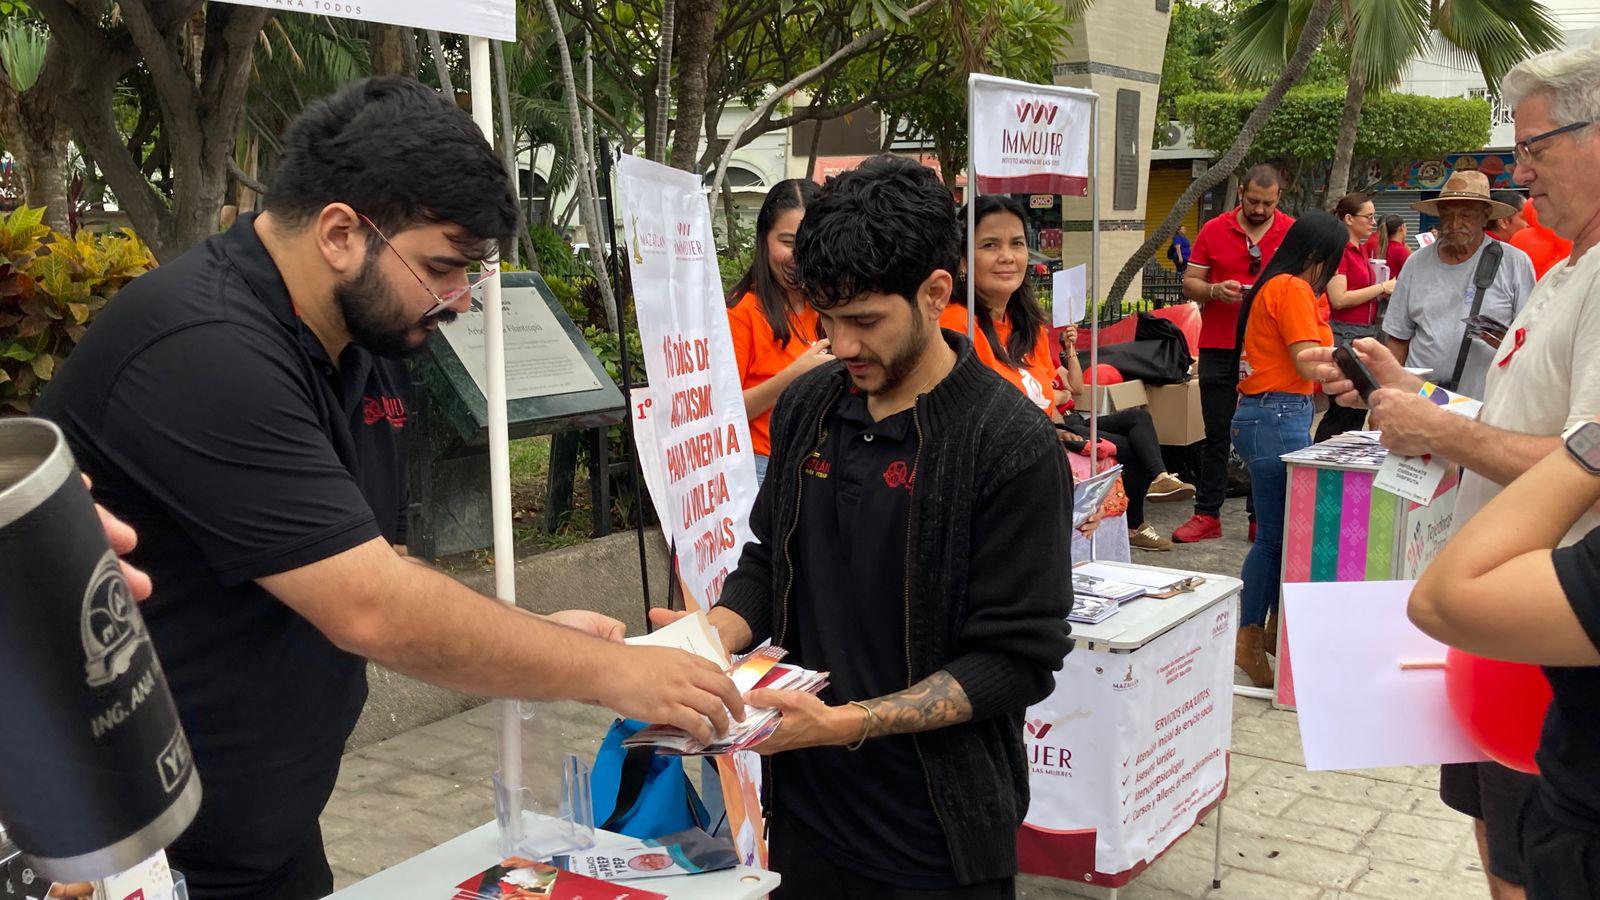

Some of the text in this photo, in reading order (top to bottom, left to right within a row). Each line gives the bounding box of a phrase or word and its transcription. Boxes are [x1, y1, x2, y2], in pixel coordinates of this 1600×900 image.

[315, 1, 362, 14] TODOS
[1002, 129, 1064, 156] IMMUJER
[663, 335, 674, 378] 16
[726, 423, 740, 456] A
[90, 669, 157, 738] ING. ANA
[1032, 767, 1073, 778] LAS MUJERES
[596, 856, 611, 872] PREP
[612, 857, 627, 869] PEP
